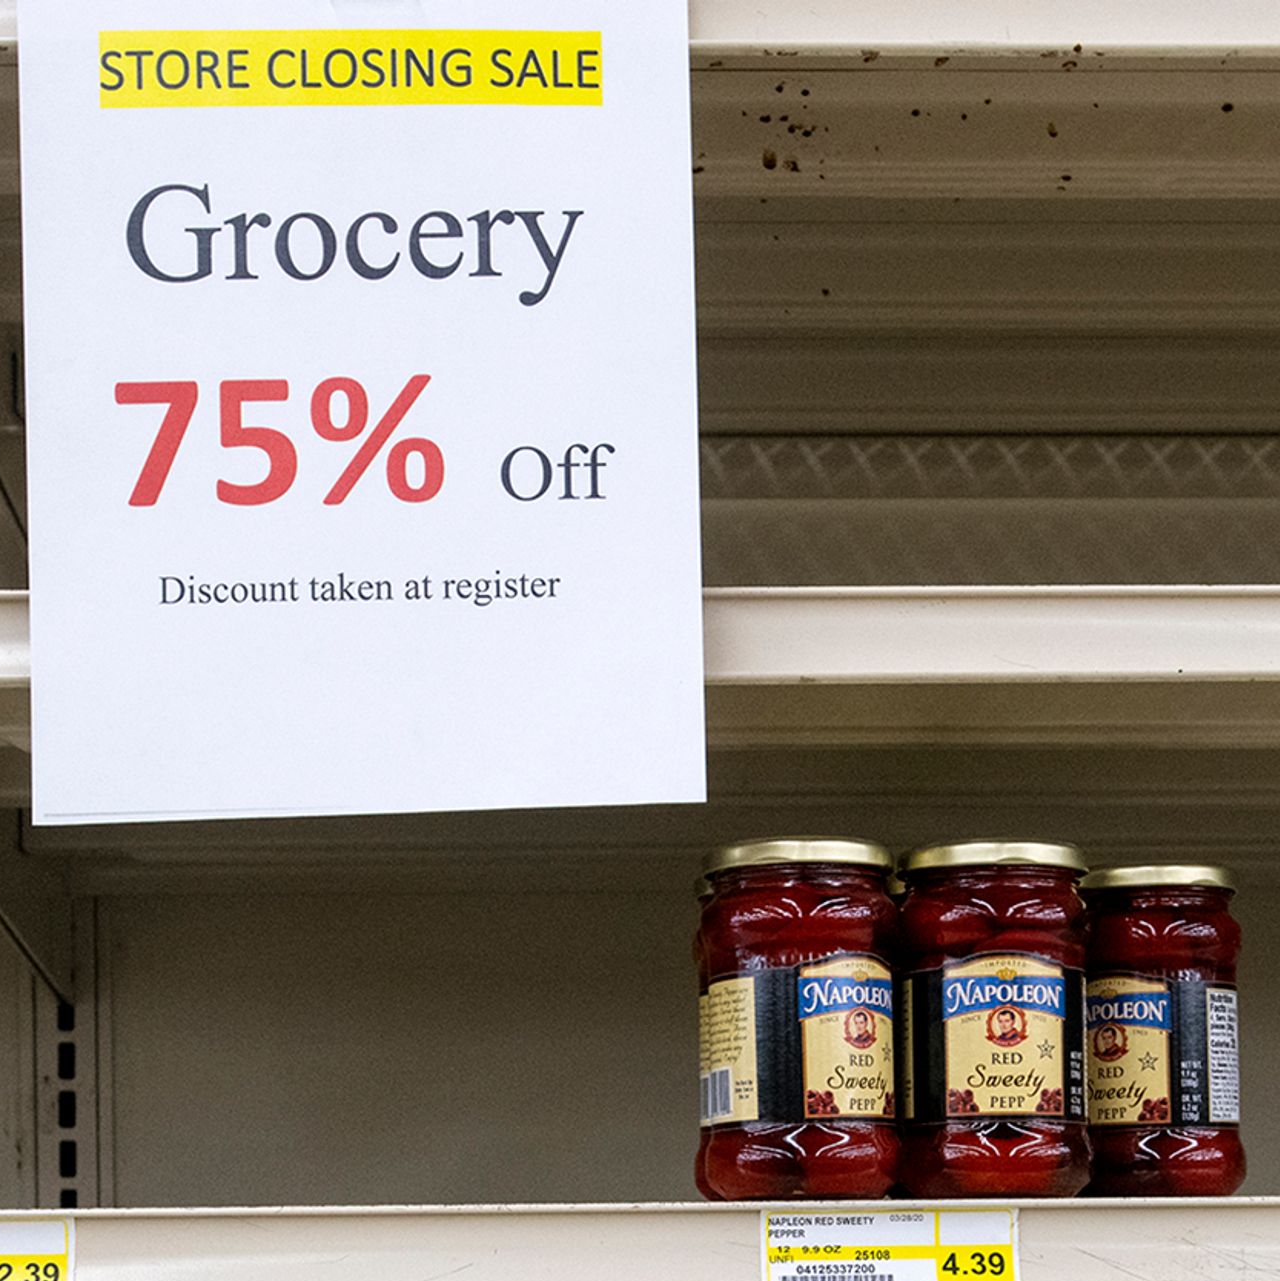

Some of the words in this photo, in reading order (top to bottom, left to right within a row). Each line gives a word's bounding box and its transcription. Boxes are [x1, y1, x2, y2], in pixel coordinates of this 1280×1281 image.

[100, 49, 250, 92] STORE
[267, 48, 472, 88] CLOSING
[490, 47, 600, 88] SALE
[125, 183, 584, 307] Grocery
[114, 374, 445, 507] 75%
[500, 443, 615, 502] Off
[159, 575, 299, 605] Discount
[309, 572, 394, 602] taken
[403, 575, 432, 601] at
[441, 572, 561, 608] register
[947, 979, 1062, 1013] NAPOLEON
[850, 1054, 874, 1067] RED
[991, 1052, 1023, 1065] RED
[1098, 1067, 1124, 1079] RED
[827, 1066, 887, 1099] Sweety
[967, 1065, 1046, 1097] Sweety
[1088, 1081, 1148, 1108] Sweety
[849, 1098, 876, 1111] PEPP
[990, 1096, 1025, 1108] PEPP
[1098, 1107, 1127, 1120] PEPP
[768, 1217, 812, 1226] NAPLEON
[814, 1216, 835, 1226] RED
[836, 1216, 875, 1226] SWEETY
[768, 1229, 805, 1238] PEPPER
[777, 1246, 790, 1254] 12
[801, 1246, 821, 1254] 9.9
[823, 1245, 842, 1253] OZ
[855, 1250, 890, 1260] 25108
[942, 1252, 1005, 1276] 4.39
